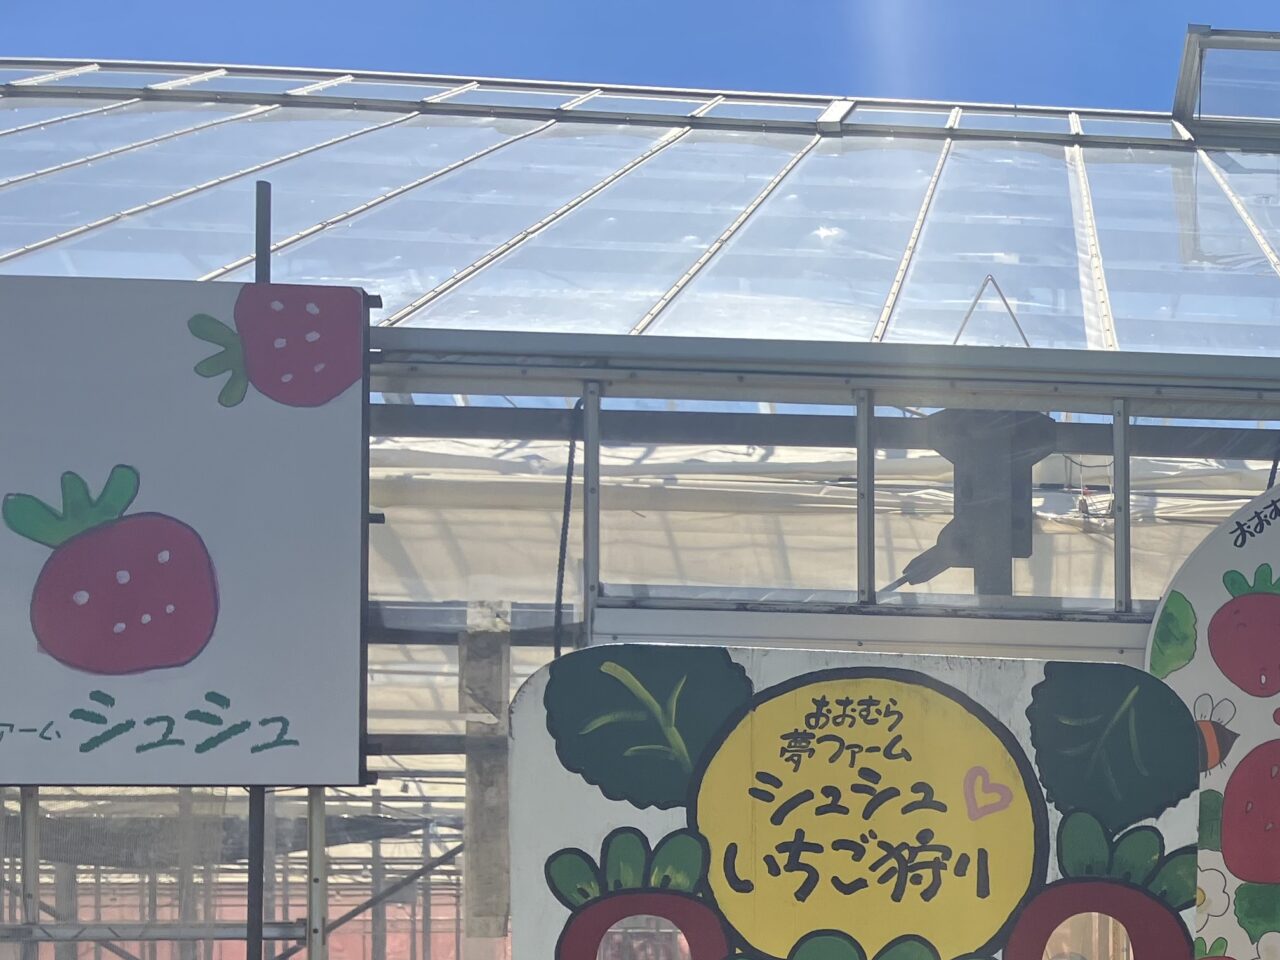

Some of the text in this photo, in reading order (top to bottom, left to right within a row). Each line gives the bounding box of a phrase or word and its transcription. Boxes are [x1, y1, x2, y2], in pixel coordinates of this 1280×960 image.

[804, 695, 904, 731] おおむら
[779, 728, 912, 772] 夢ファーム
[748, 767, 948, 826] シュシュ
[722, 828, 991, 902] いちご狩り
